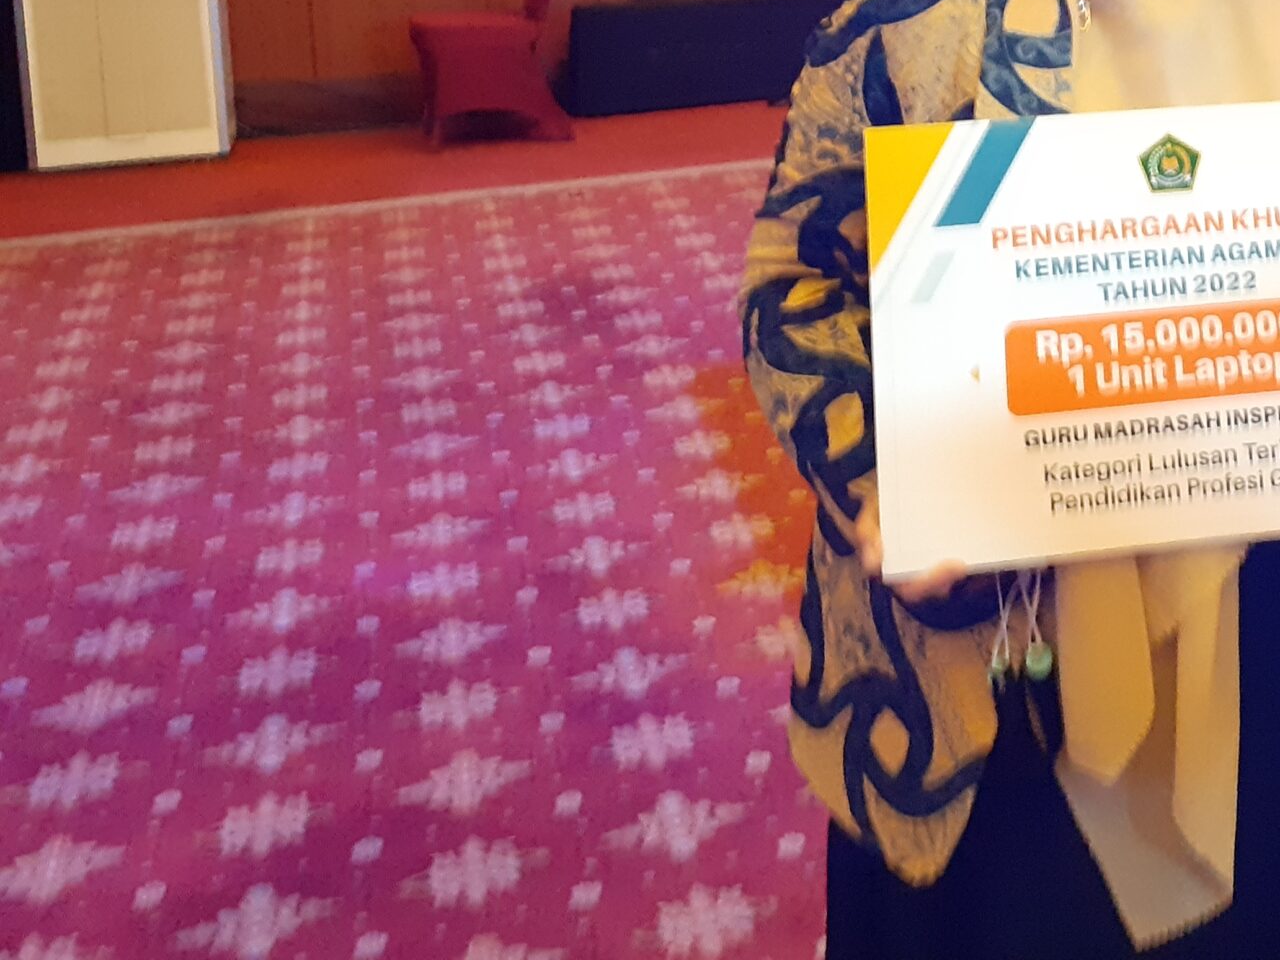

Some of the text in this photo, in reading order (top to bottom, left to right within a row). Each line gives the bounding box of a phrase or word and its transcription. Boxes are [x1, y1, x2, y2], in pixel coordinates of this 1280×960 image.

[991, 210, 1225, 250] PENGHARGAAN
[1015, 245, 1205, 279] KEMENTERIAN
[1097, 270, 1257, 302] TAHUN 2022
[1035, 329, 1094, 366] Rp.
[1068, 364, 1086, 396] 1
[1096, 357, 1168, 391] Unit
[1024, 424, 1088, 449] GURU
[1094, 411, 1221, 440] MADRASAH
[1044, 453, 1142, 484] Kategori
[1149, 446, 1238, 472] Lulusan
[1050, 480, 1182, 513] Pendidikan
[1187, 470, 1265, 499] Profesi
